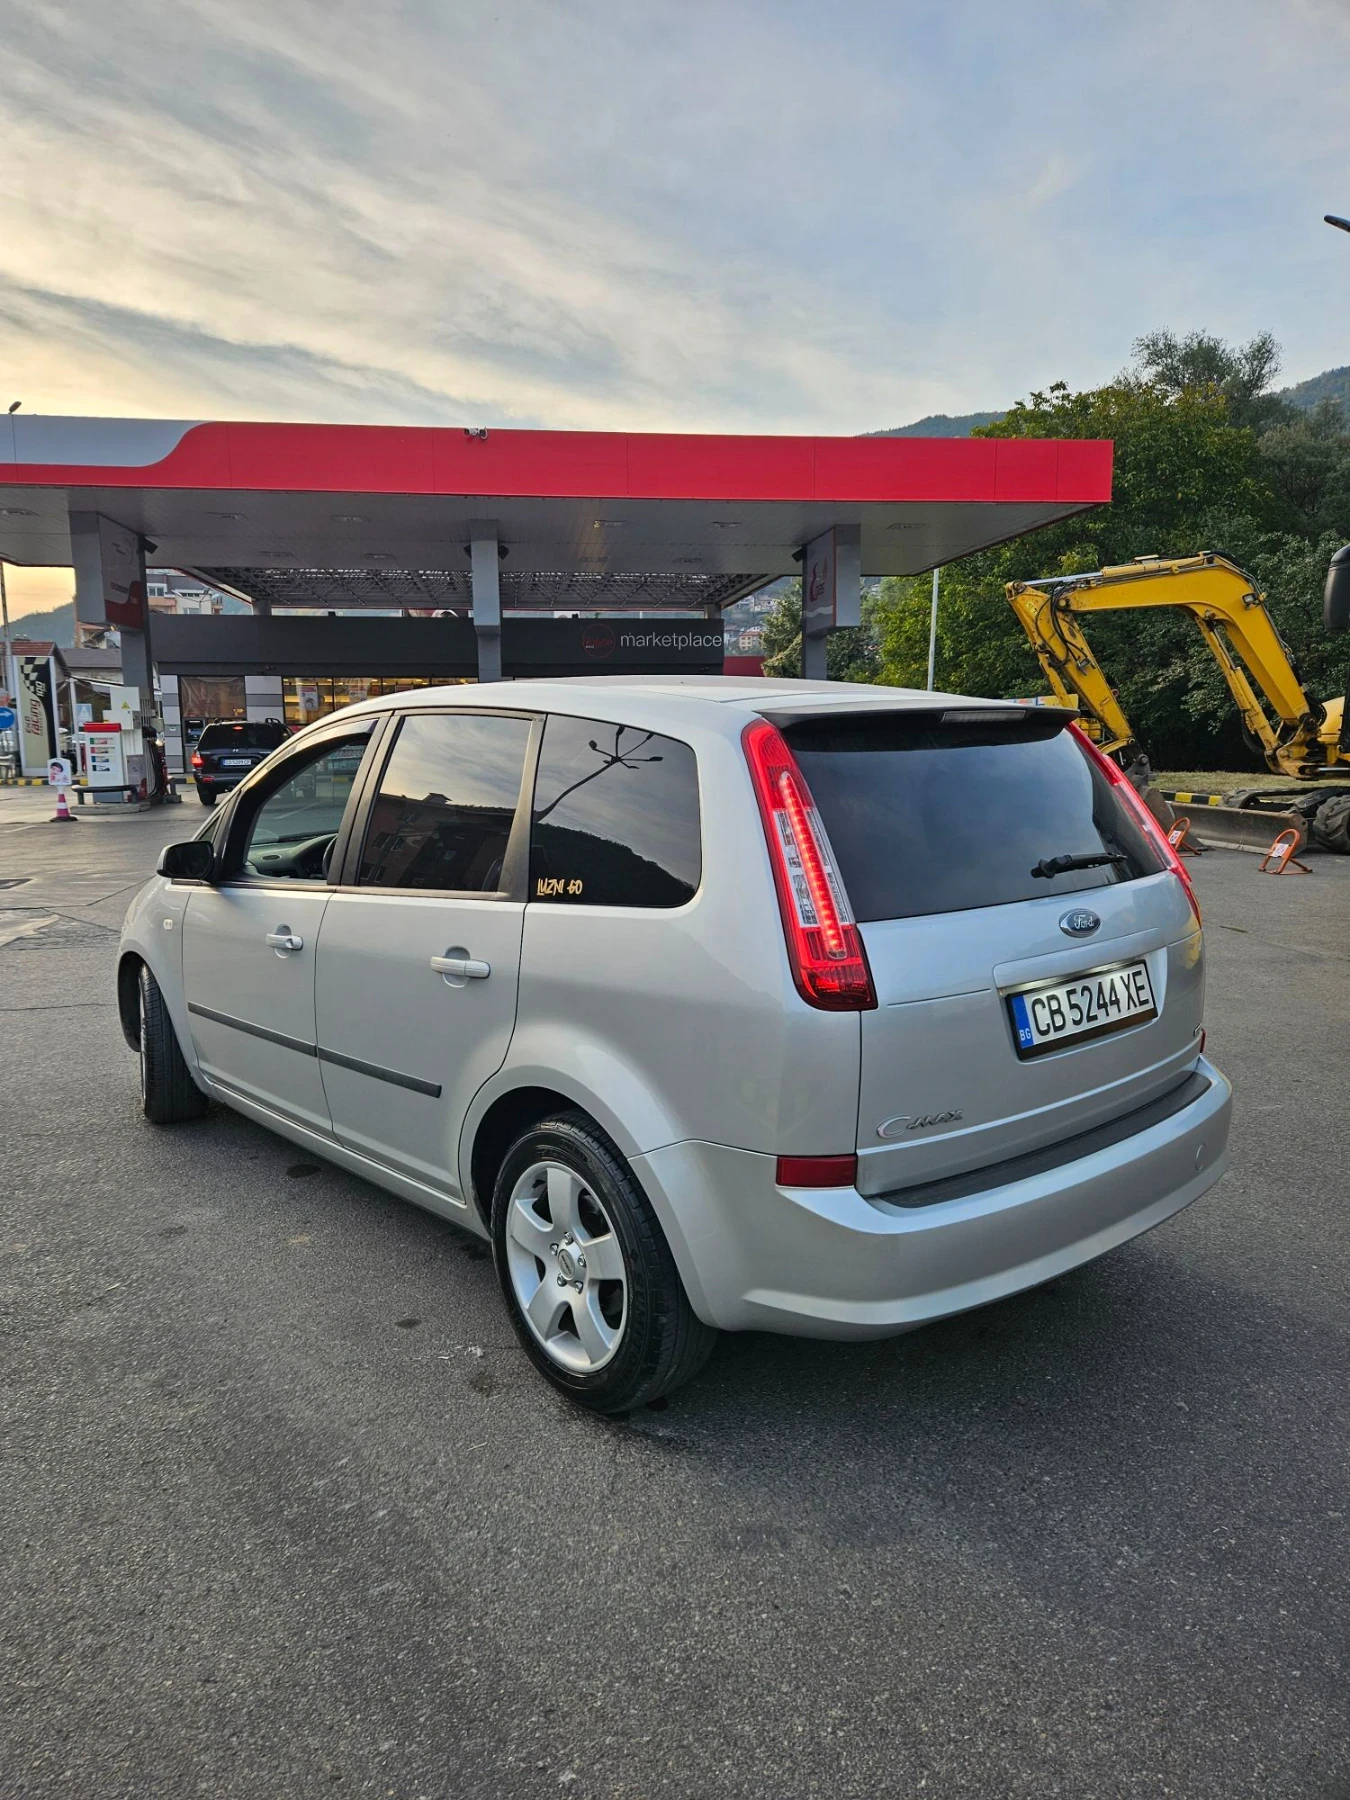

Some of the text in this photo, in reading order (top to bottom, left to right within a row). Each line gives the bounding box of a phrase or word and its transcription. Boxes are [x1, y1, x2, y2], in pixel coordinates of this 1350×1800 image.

[620, 631, 722, 650] marketplace
[30, 698, 41, 736] racing
[1073, 914, 1095, 930] Ford
[1019, 1027, 1032, 1042] BG
